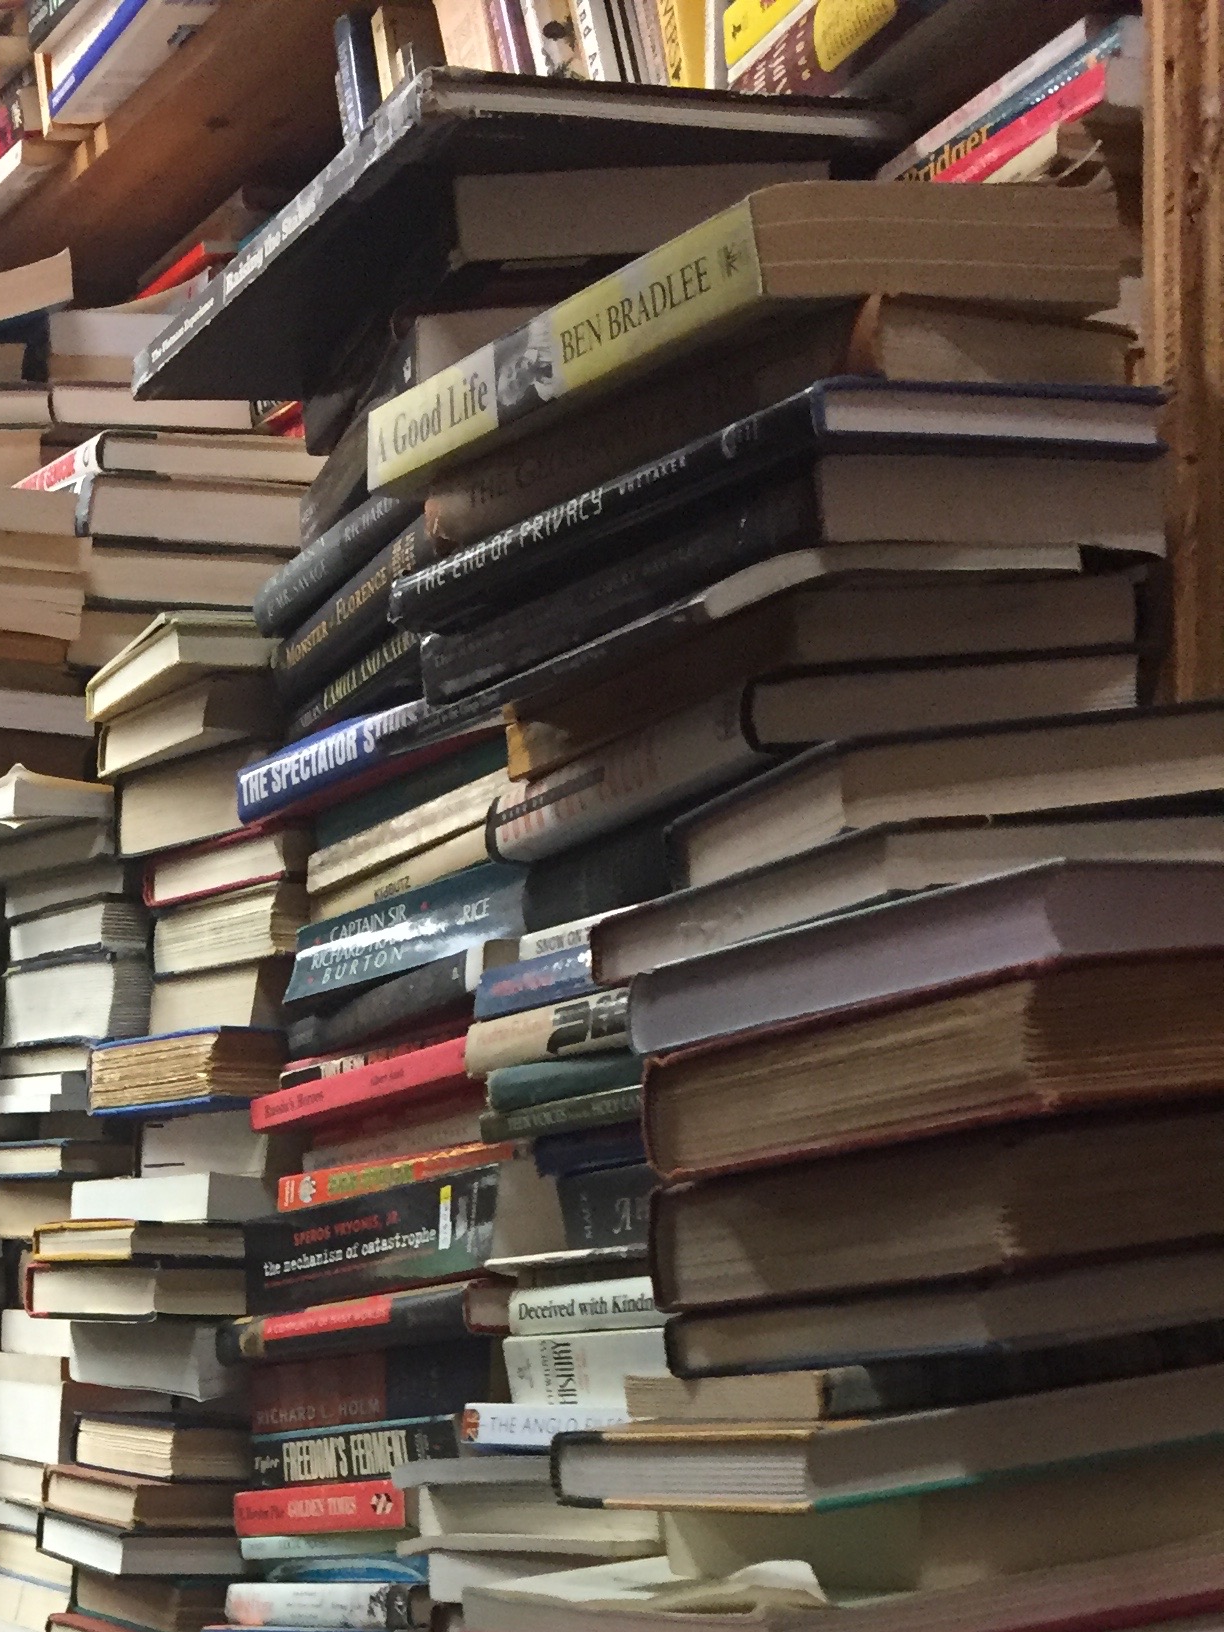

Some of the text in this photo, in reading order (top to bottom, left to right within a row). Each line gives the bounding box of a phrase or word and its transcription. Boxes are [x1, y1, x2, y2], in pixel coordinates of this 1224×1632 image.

[376, 258, 713, 463] A Good Life BEN BRADLEE
[414, 560, 447, 594] THE
[490, 530, 513, 559] OF
[519, 492, 604, 551] PRIVACY
[334, 566, 388, 626] FLORENCE
[239, 729, 359, 807] THE SPECTATOR
[329, 904, 407, 943] CAPTAIN SIR
[321, 947, 404, 985] BURTON
[263, 1227, 437, 1278] the mechanism of catastrophe
[519, 1298, 575, 1321] Deceived
[579, 1296, 608, 1316] with
[490, 1416, 517, 1434] THE
[282, 1435, 349, 1482] FREEDOM'S
[349, 1428, 409, 1477] FERMENT
